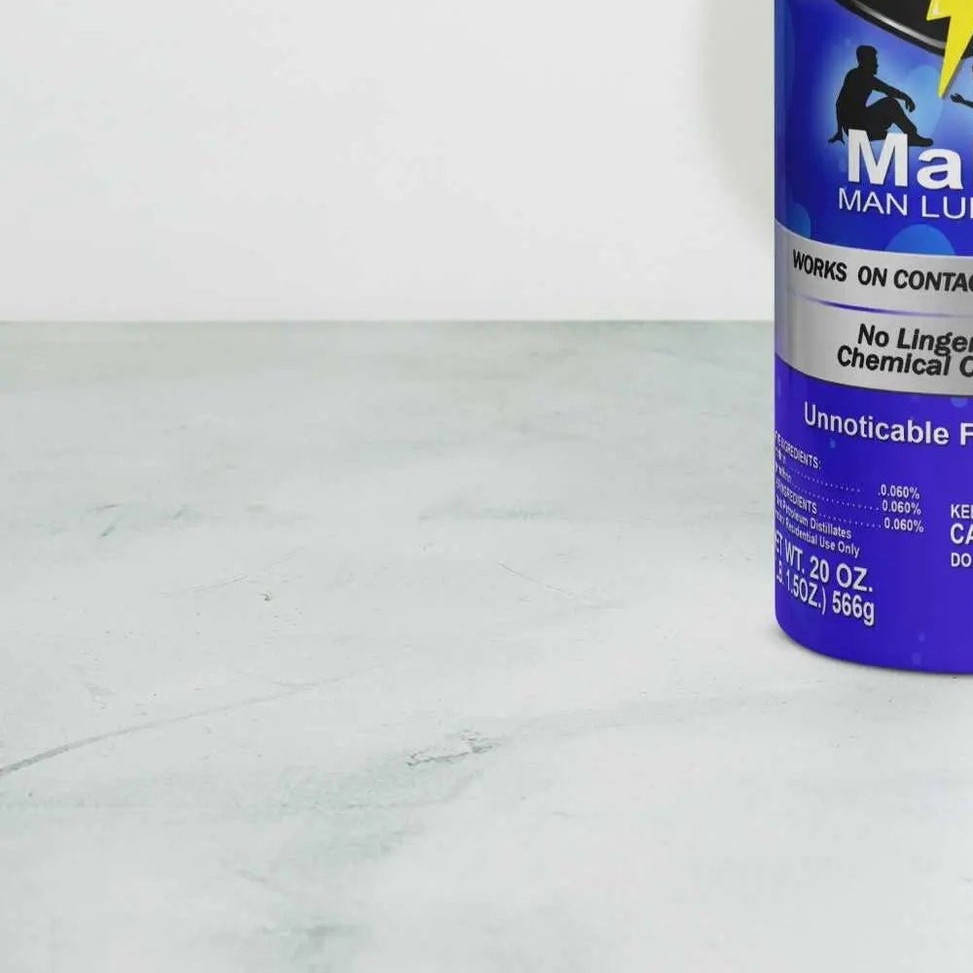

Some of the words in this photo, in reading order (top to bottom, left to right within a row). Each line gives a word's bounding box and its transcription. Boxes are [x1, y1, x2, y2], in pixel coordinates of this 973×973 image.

[838, 187, 909, 217] MAN
[793, 249, 848, 282] WORKS
[857, 265, 888, 287] ON
[857, 323, 890, 347] No
[837, 345, 951, 376] Chemical
[804, 401, 950, 445] Unnoticable
[810, 517, 852, 540] Distillates
[819, 535, 836, 551] Use
[837, 540, 860, 559] Only
[950, 552, 971, 568] DO
[784, 538, 805, 575] WT.
[809, 554, 830, 583] 20
[836, 562, 873, 593] OZ.
[831, 589, 876, 627] 566g
